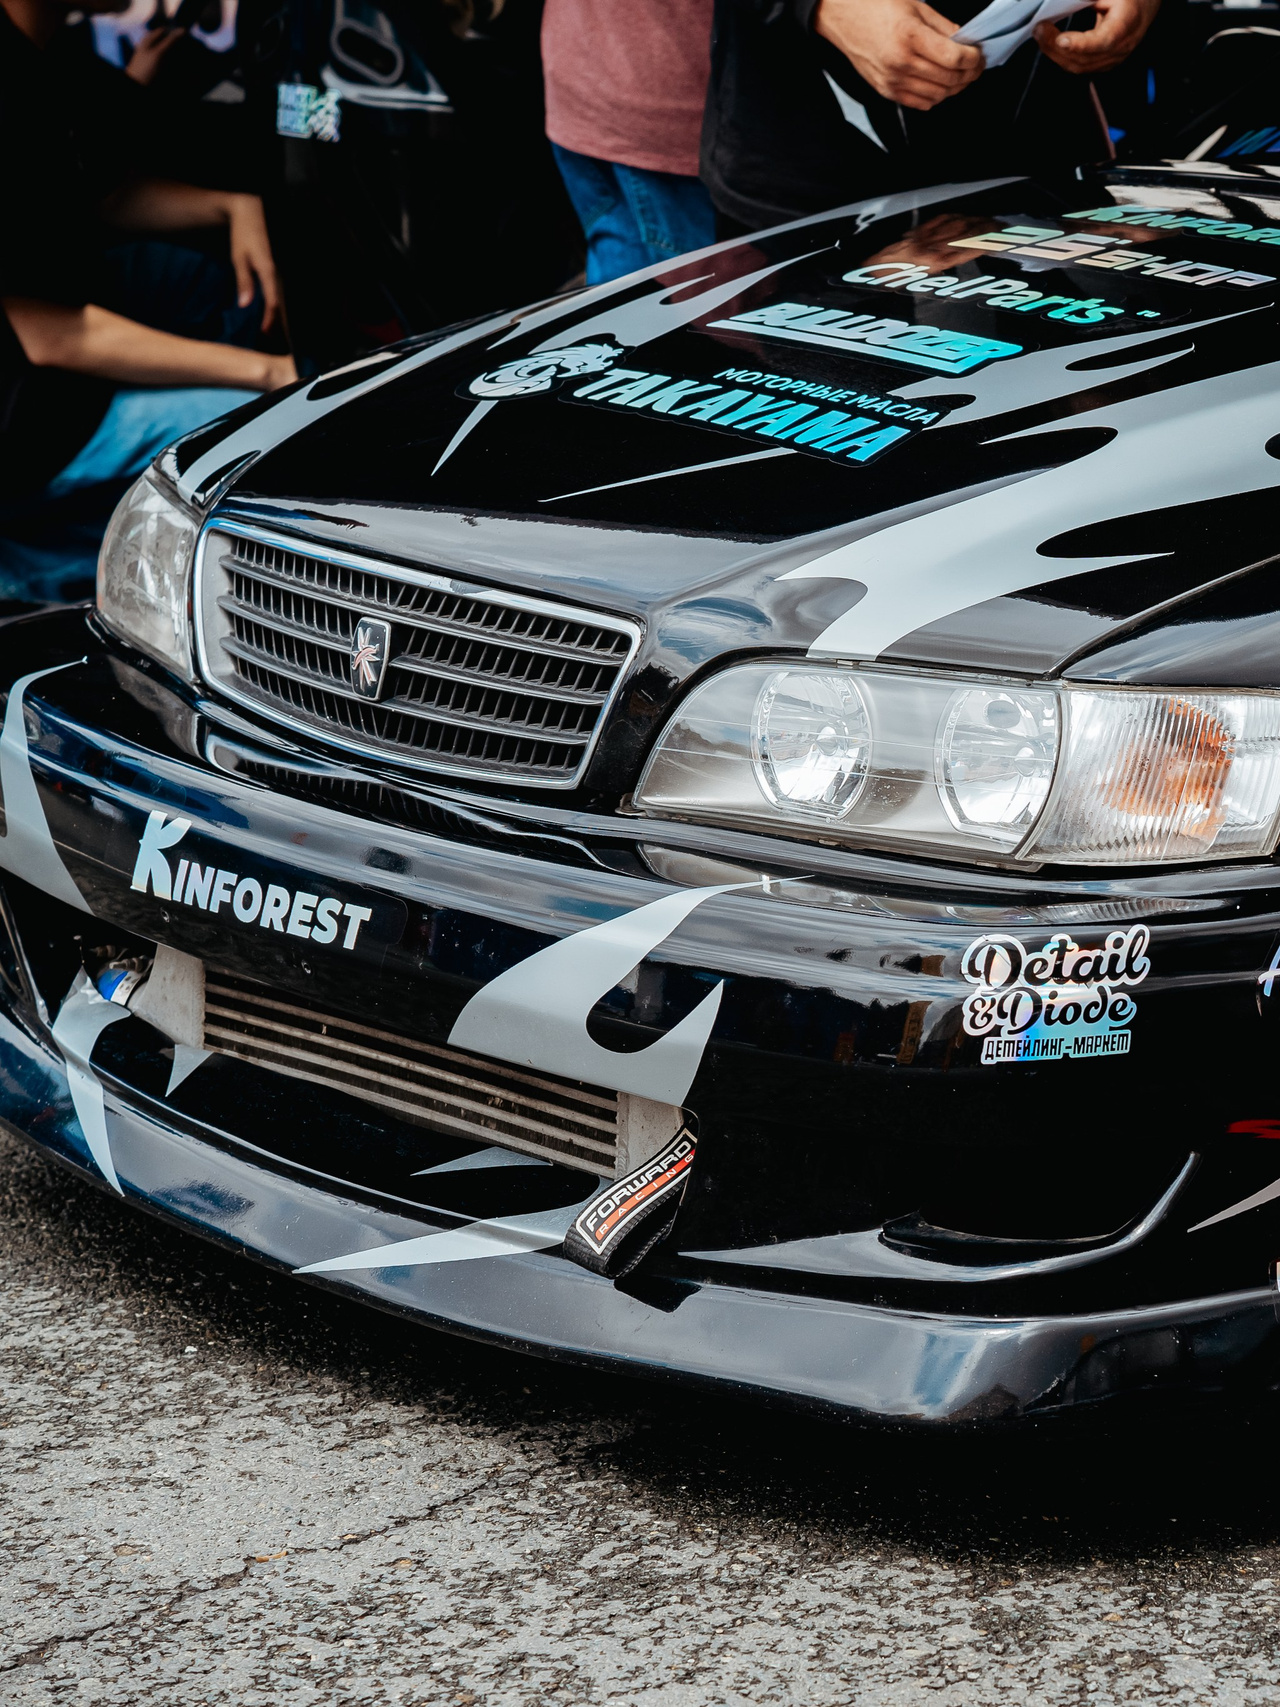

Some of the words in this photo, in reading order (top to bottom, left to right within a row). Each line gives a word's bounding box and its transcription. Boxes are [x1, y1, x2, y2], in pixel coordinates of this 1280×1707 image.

[841, 263, 1125, 325] ChelParts
[728, 302, 1024, 362] BULLDOZER
[573, 367, 911, 462] TAKAYAMA
[713, 368, 857, 402] МОТОРНЫЕ
[845, 392, 941, 425] МАСЛА
[130, 810, 372, 950] KINFOREST
[965, 926, 1149, 989] Detail
[586, 1140, 692, 1232] FORWARD
[599, 1154, 694, 1235] RACING
